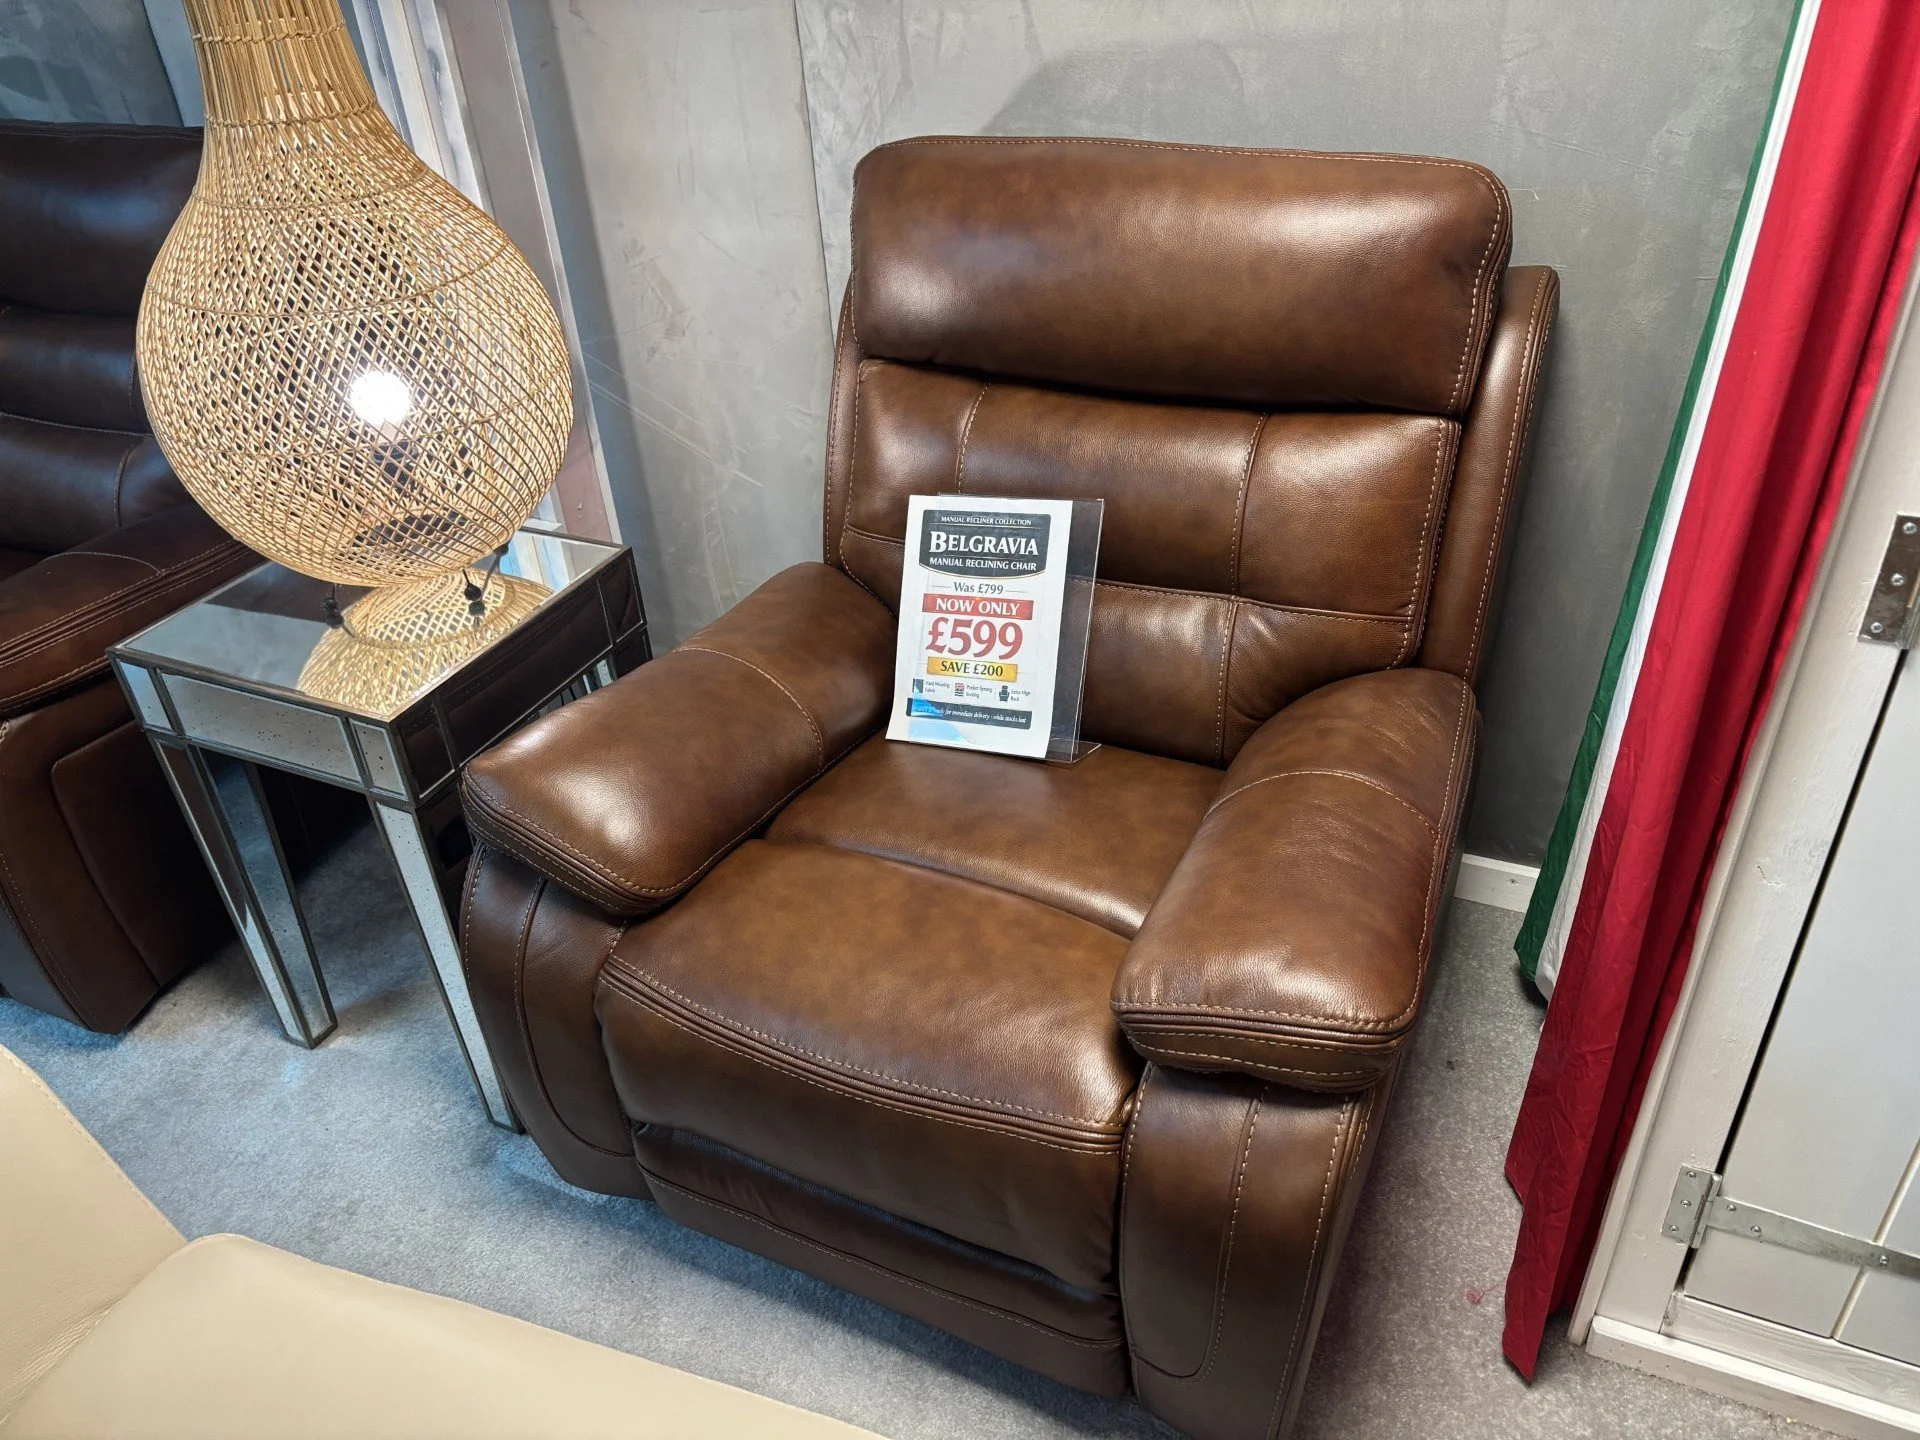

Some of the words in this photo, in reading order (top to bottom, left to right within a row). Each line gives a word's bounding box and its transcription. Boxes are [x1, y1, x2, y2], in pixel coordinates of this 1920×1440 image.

[994, 518, 1031, 526] COLLECTION
[929, 531, 1039, 556] BELGRAVIA
[929, 557, 964, 567] MANUAL
[965, 559, 1009, 570] RECLINING
[1010, 561, 1037, 571] CHAIR
[953, 582, 975, 593] Was
[978, 583, 1004, 595] £799
[935, 597, 975, 612] NOW
[978, 600, 1020, 616] ONLY
[925, 616, 1023, 660] £599
[940, 661, 971, 674] SAVE
[973, 663, 1004, 677] £200
